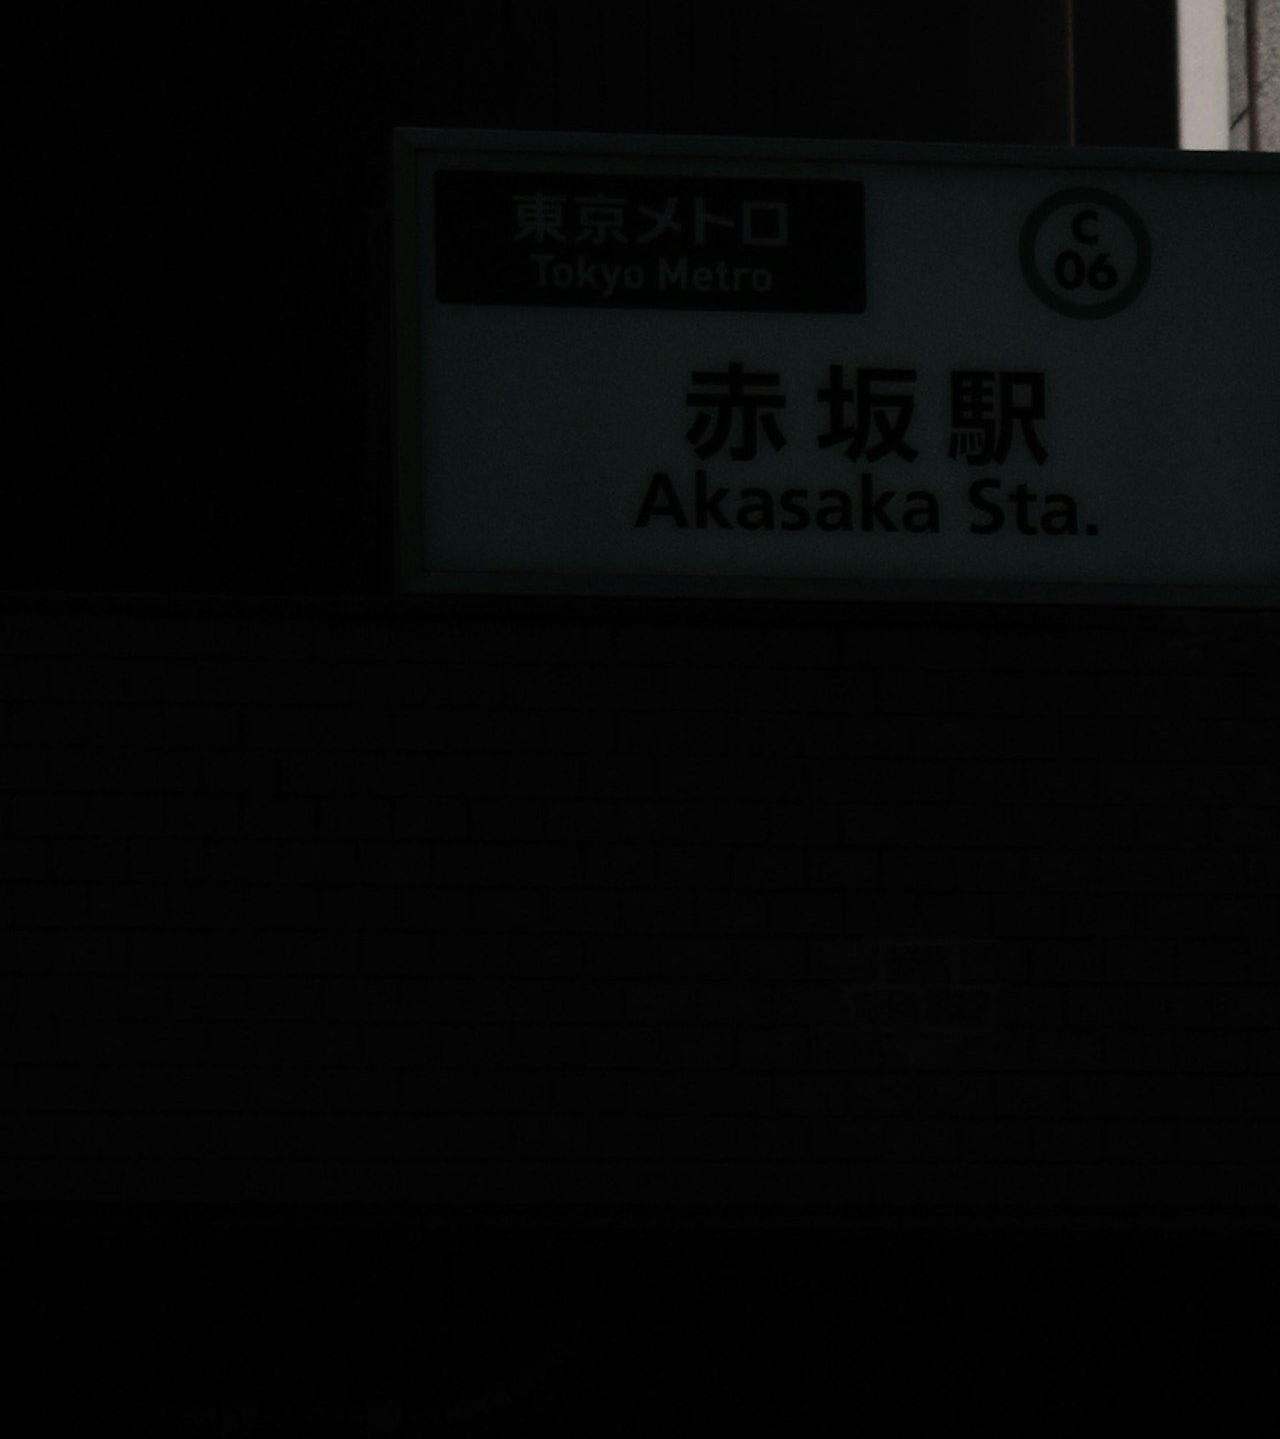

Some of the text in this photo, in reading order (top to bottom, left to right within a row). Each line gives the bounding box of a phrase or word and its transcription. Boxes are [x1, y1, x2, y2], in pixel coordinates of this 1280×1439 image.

[510, 191, 791, 250] 東京メトロ
[1071, 210, 1099, 246] C
[530, 252, 774, 297] Tokyo Metro
[1054, 251, 1118, 291] 06
[686, 362, 1049, 466] 赤坂駅
[635, 471, 1100, 537] Akasaka Sta.
